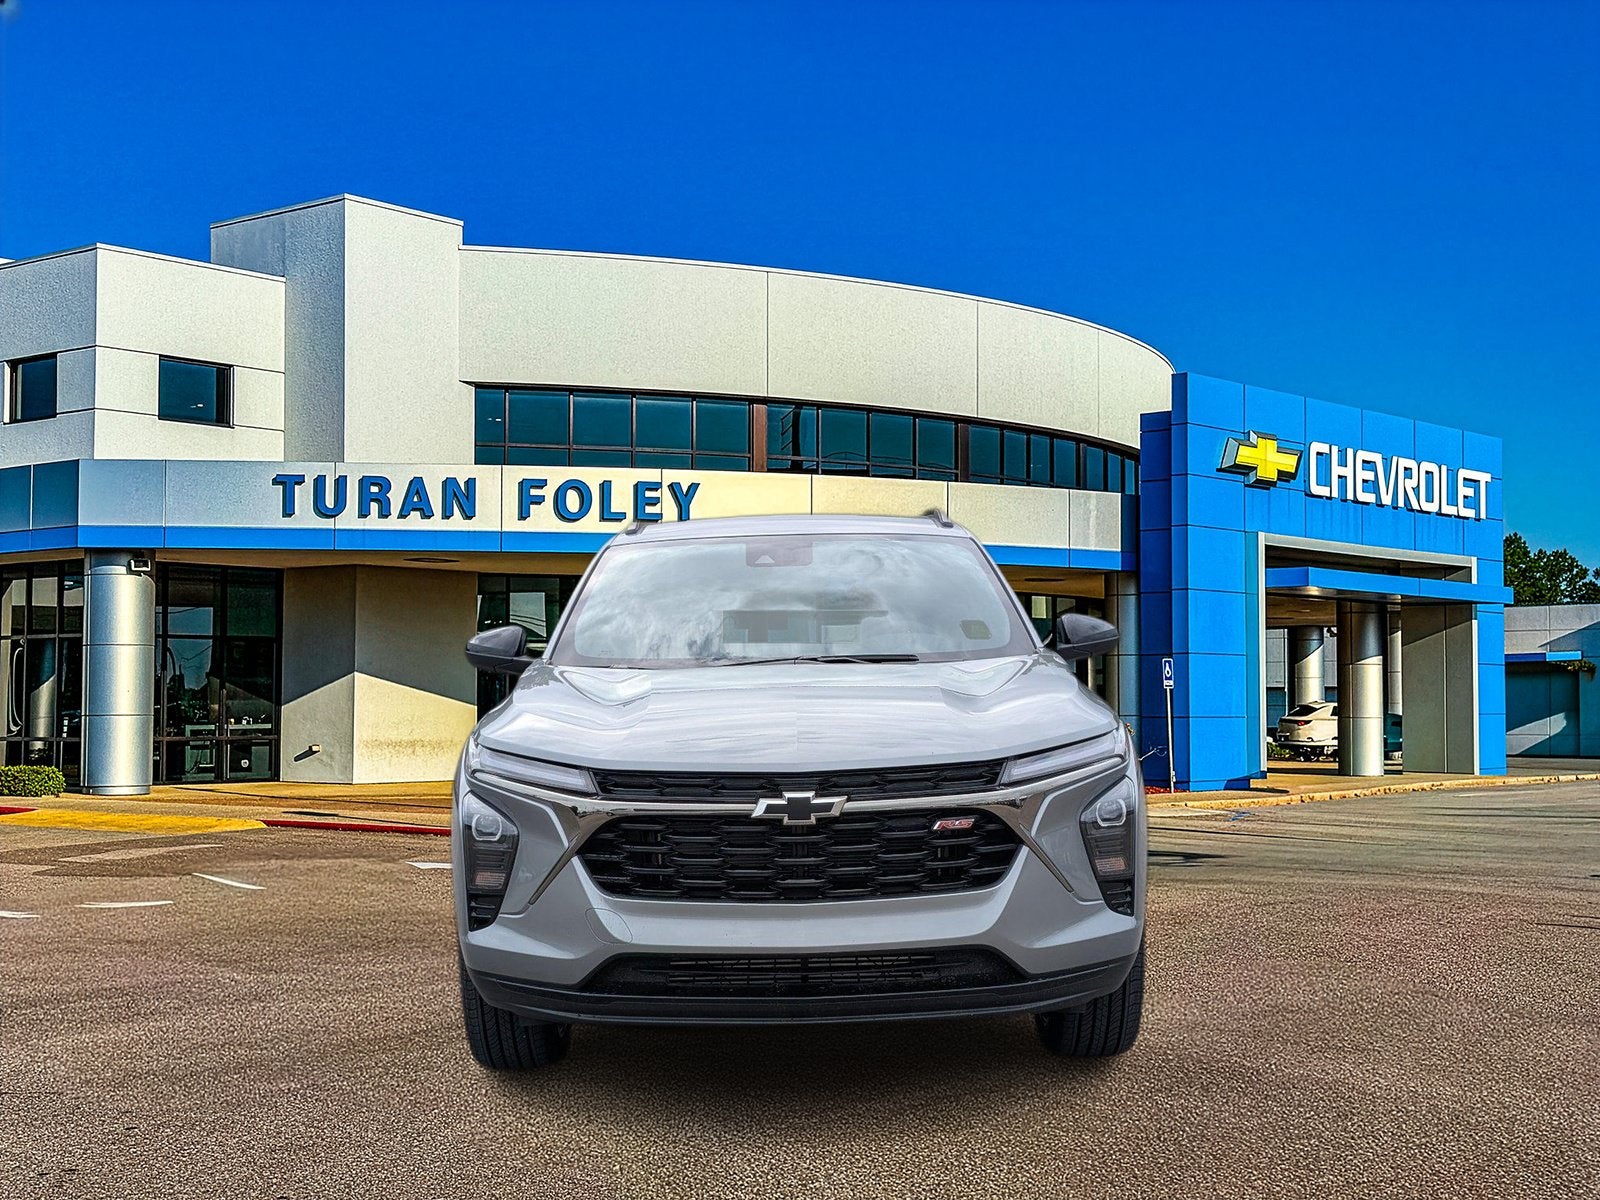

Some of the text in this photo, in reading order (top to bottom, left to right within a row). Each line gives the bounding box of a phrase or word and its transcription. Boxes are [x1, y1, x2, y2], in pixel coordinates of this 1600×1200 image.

[272, 474, 700, 521] TURAN FOLEY
[1309, 441, 1491, 519] CHEVROLET
[933, 818, 975, 830] RS
